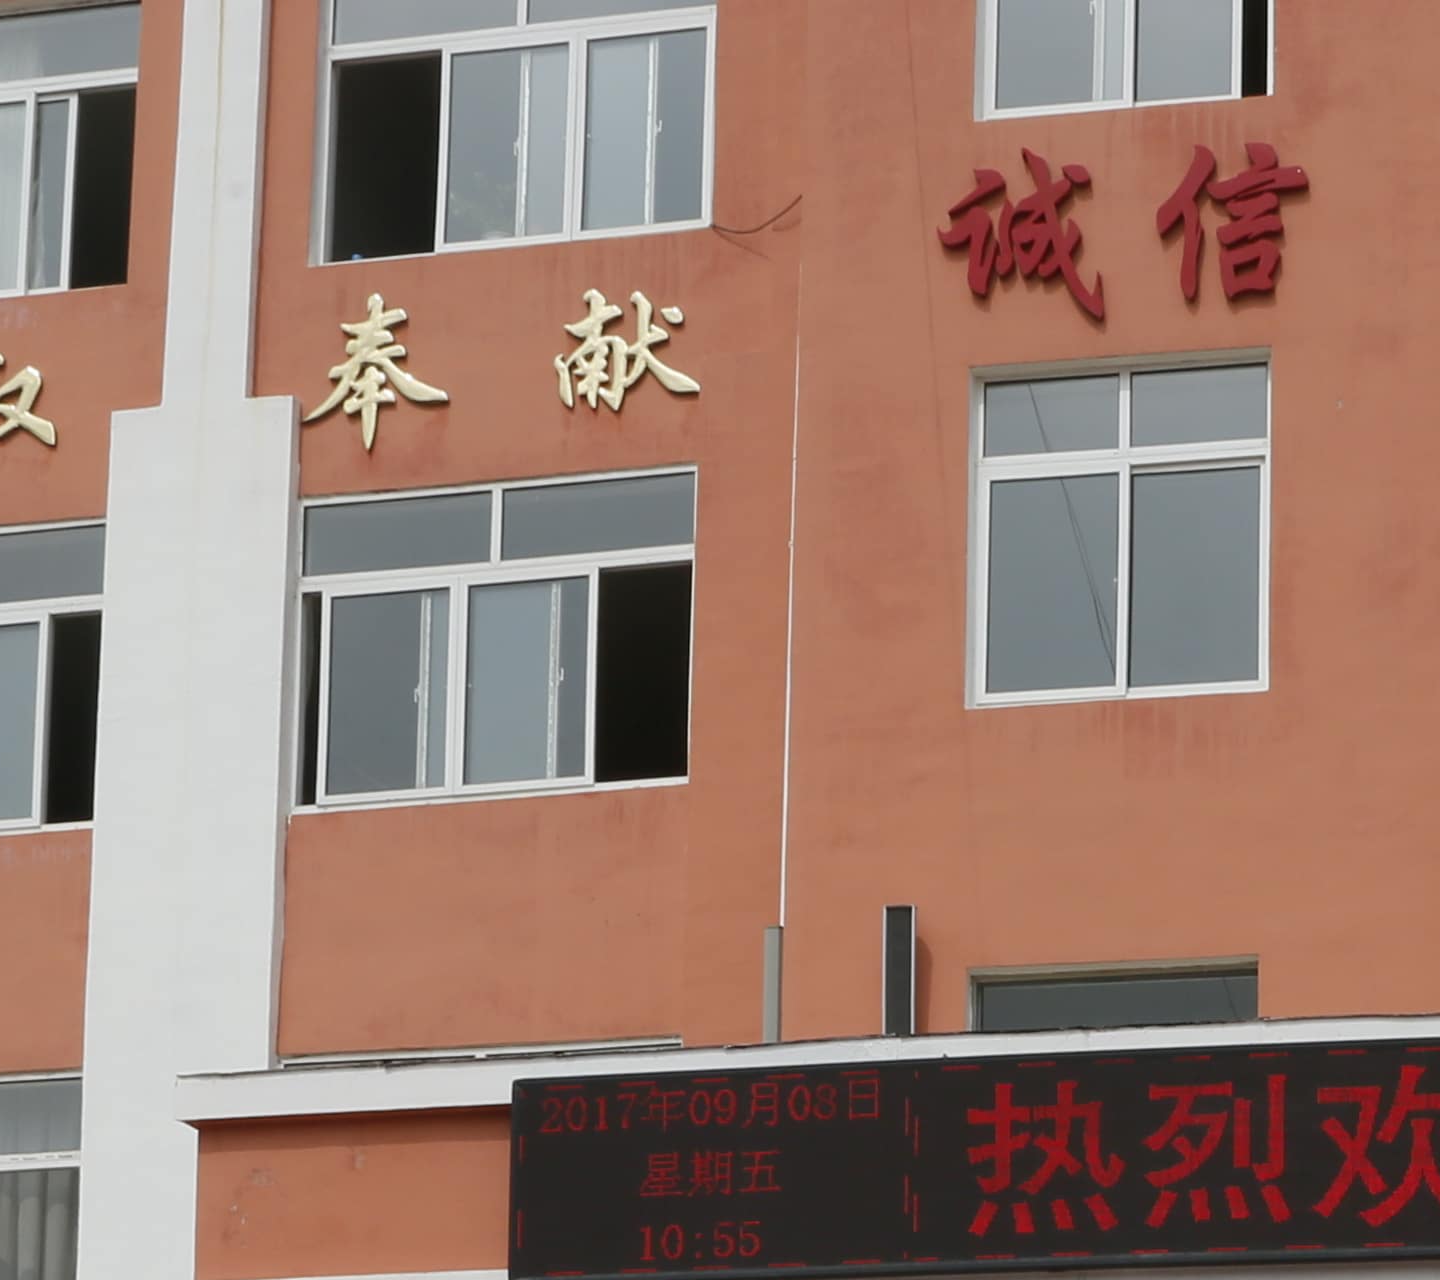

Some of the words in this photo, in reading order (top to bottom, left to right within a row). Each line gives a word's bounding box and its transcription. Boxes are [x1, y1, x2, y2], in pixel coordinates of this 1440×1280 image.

[938, 142, 1310, 322] 诚信
[302, 288, 702, 452] 奉献
[539, 1078, 881, 1136] 2017年09月08日
[637, 1148, 783, 1199] 星期五
[637, 1220, 763, 1262] 10:55
